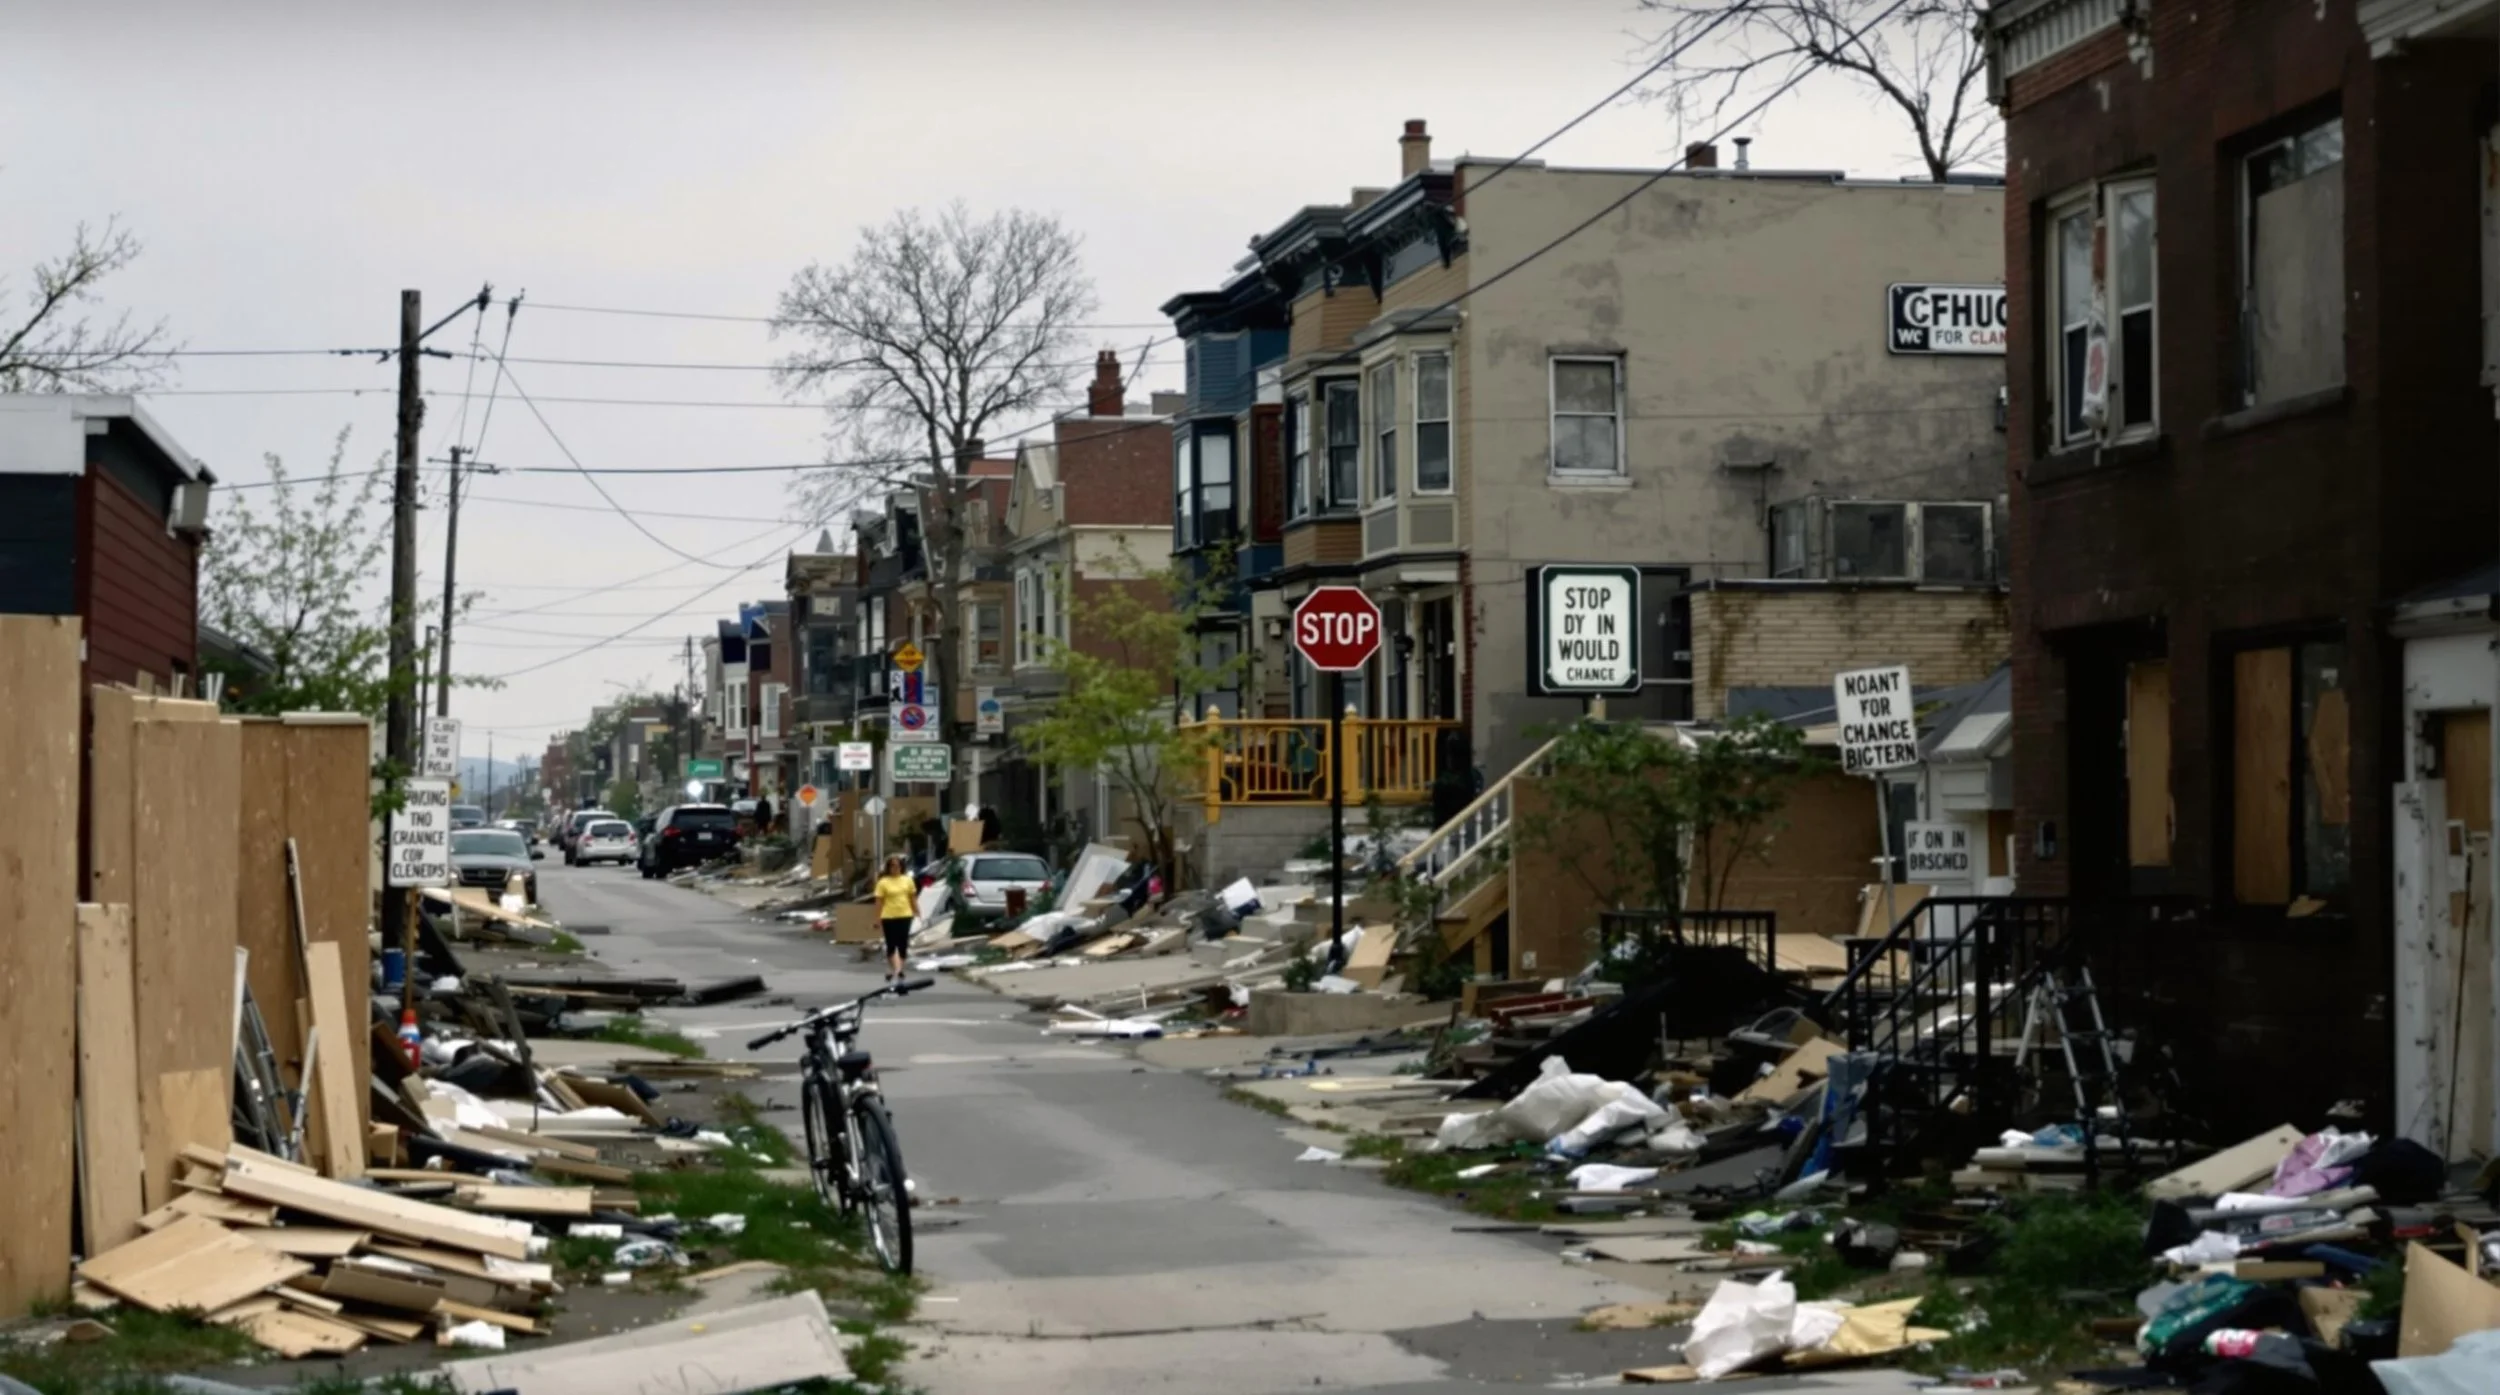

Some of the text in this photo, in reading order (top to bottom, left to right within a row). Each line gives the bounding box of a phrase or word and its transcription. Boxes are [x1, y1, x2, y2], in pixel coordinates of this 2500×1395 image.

[1935, 330, 1963, 345] FOR
[1565, 587, 1612, 610] STOP
[1301, 612, 1375, 646] STOP
[1564, 614, 1615, 635] DY IN
[1558, 639, 1620, 661] WOULD
[1566, 667, 1616, 681] CHANCE
[1843, 720, 1912, 744] CHANCE
[1924, 830, 1944, 849] ON
[1952, 830, 1966, 849] IN
